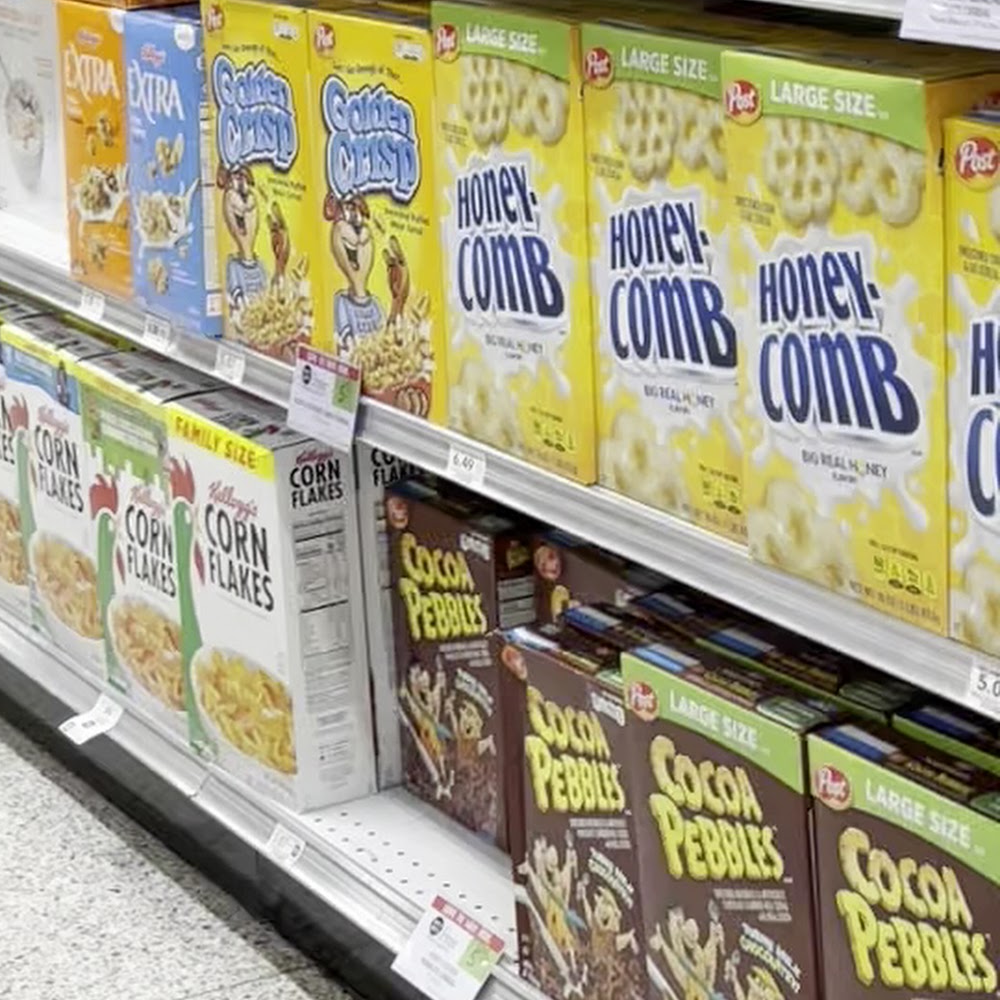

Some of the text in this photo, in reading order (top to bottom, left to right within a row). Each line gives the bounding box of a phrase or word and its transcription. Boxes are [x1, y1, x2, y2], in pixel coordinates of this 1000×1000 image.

[466, 23, 538, 52] LARGE SIZE
[621, 47, 707, 80] LARGE SIZE
[127, 59, 186, 124] EXTRA
[726, 82, 758, 114] Post
[770, 79, 877, 118] LARGE SIZE
[957, 139, 1000, 178] Post
[34, 424, 80, 479] CORN
[175, 416, 258, 470] FAMILY SIZE
[452, 452, 476, 472] 6.49
[38, 462, 85, 514] FLAKES
[289, 458, 342, 489] CORN
[292, 482, 345, 510] FLAKES
[125, 504, 173, 564] CORN
[204, 502, 271, 573] CORN
[127, 543, 177, 599] FLAKES
[207, 548, 275, 613] FLAKES
[669, 689, 759, 750] LARGE SIZE
[651, 734, 763, 823] COCOA
[649, 792, 785, 881] PEBBLES
[865, 778, 972, 849] LARGE SIZE
[838, 826, 974, 931] COCOA
[836, 888, 998, 994] PEBBLES
